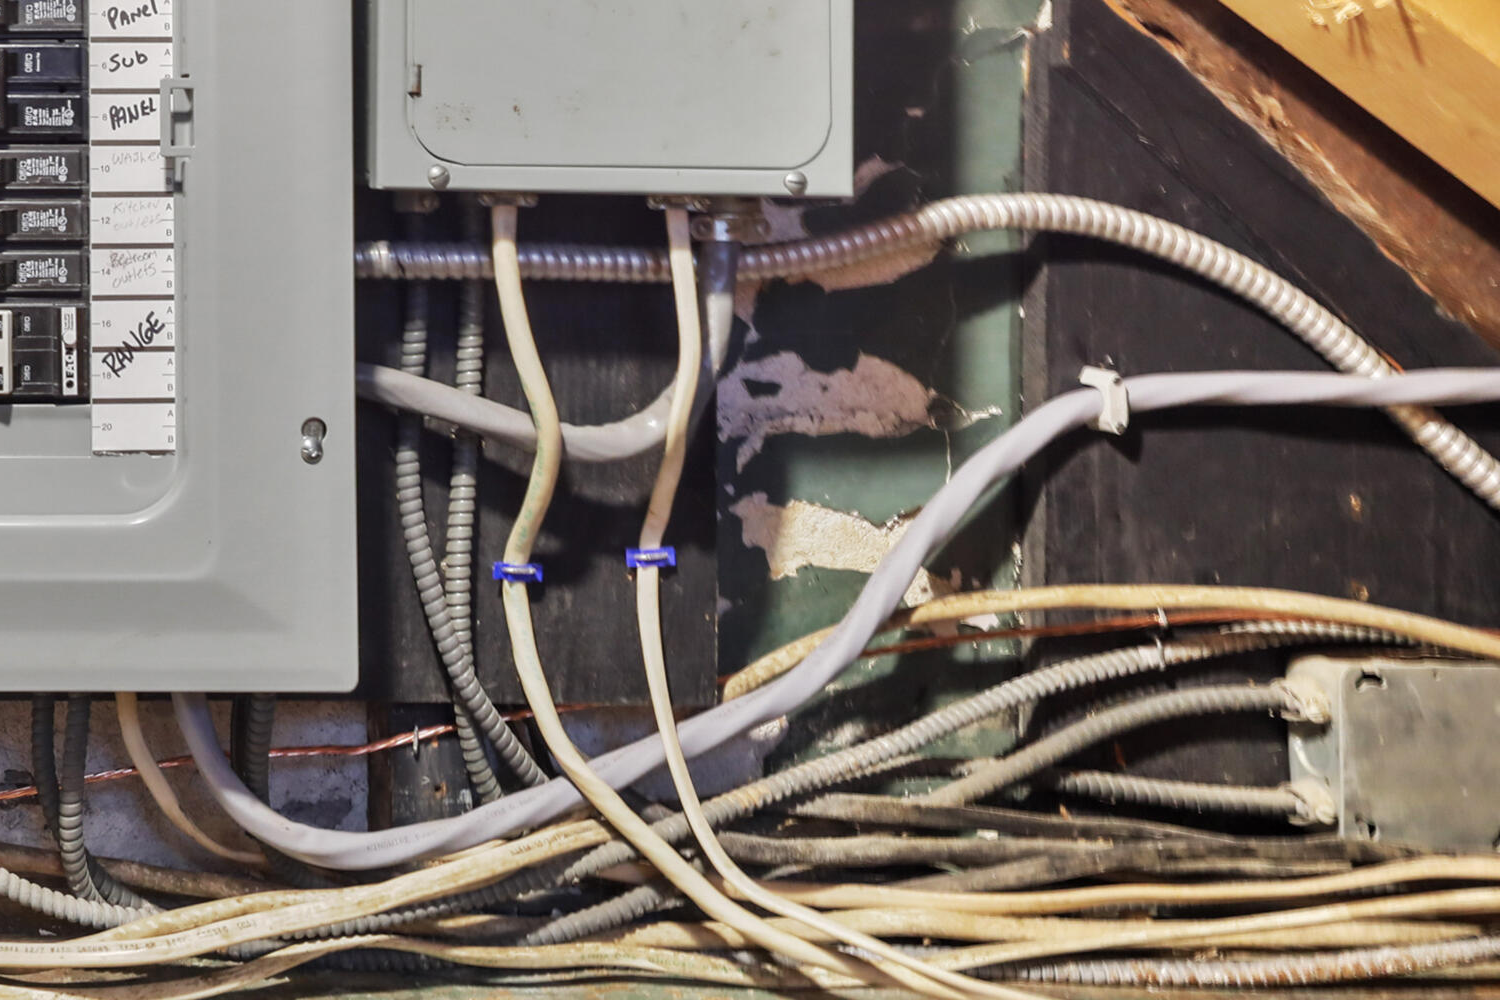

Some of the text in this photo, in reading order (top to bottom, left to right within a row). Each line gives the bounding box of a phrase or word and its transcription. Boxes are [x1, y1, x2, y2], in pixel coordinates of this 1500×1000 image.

[164, 23, 170, 31] B
[109, 50, 148, 72] Sub
[109, 97, 156, 130] PANEL
[166, 280, 172, 288] B
[167, 306, 173, 314] A
[167, 332, 172, 340] B
[102, 311, 165, 378] RANGE
[102, 423, 112, 431] 20
[168, 435, 173, 443] B
